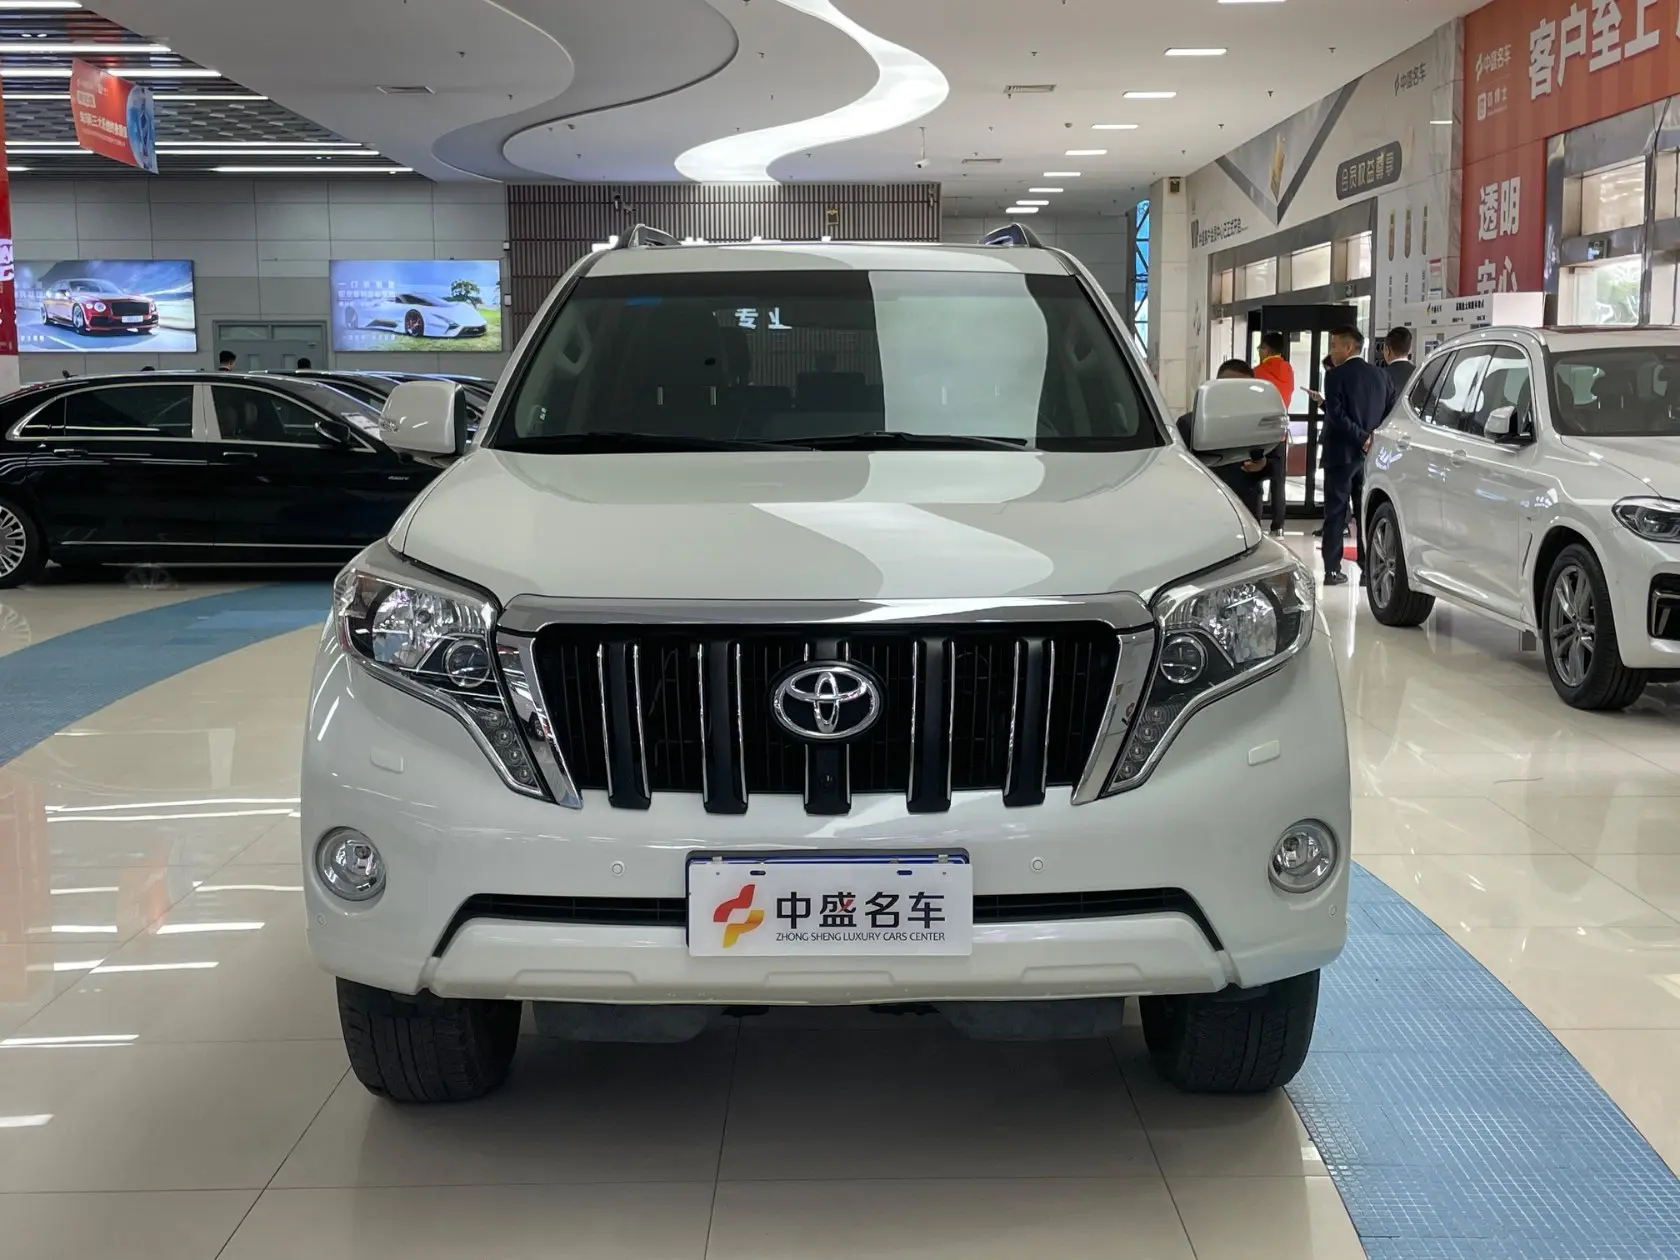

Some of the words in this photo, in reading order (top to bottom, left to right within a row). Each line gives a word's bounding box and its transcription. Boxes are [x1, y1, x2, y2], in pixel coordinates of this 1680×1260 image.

[1529, 0, 1660, 100] 客户至上
[1400, 62, 1426, 91] 中盛名车
[1341, 151, 1394, 192] 会员权益尊享
[1479, 177, 1520, 241] 透明
[776, 891, 946, 930] 中盛名车
[776, 932, 809, 942] ZHONG
[811, 932, 842, 942] SHENG
[843, 932, 881, 942] LUXURY
[883, 932, 908, 942] CARS
[909, 932, 946, 942] CENTER
